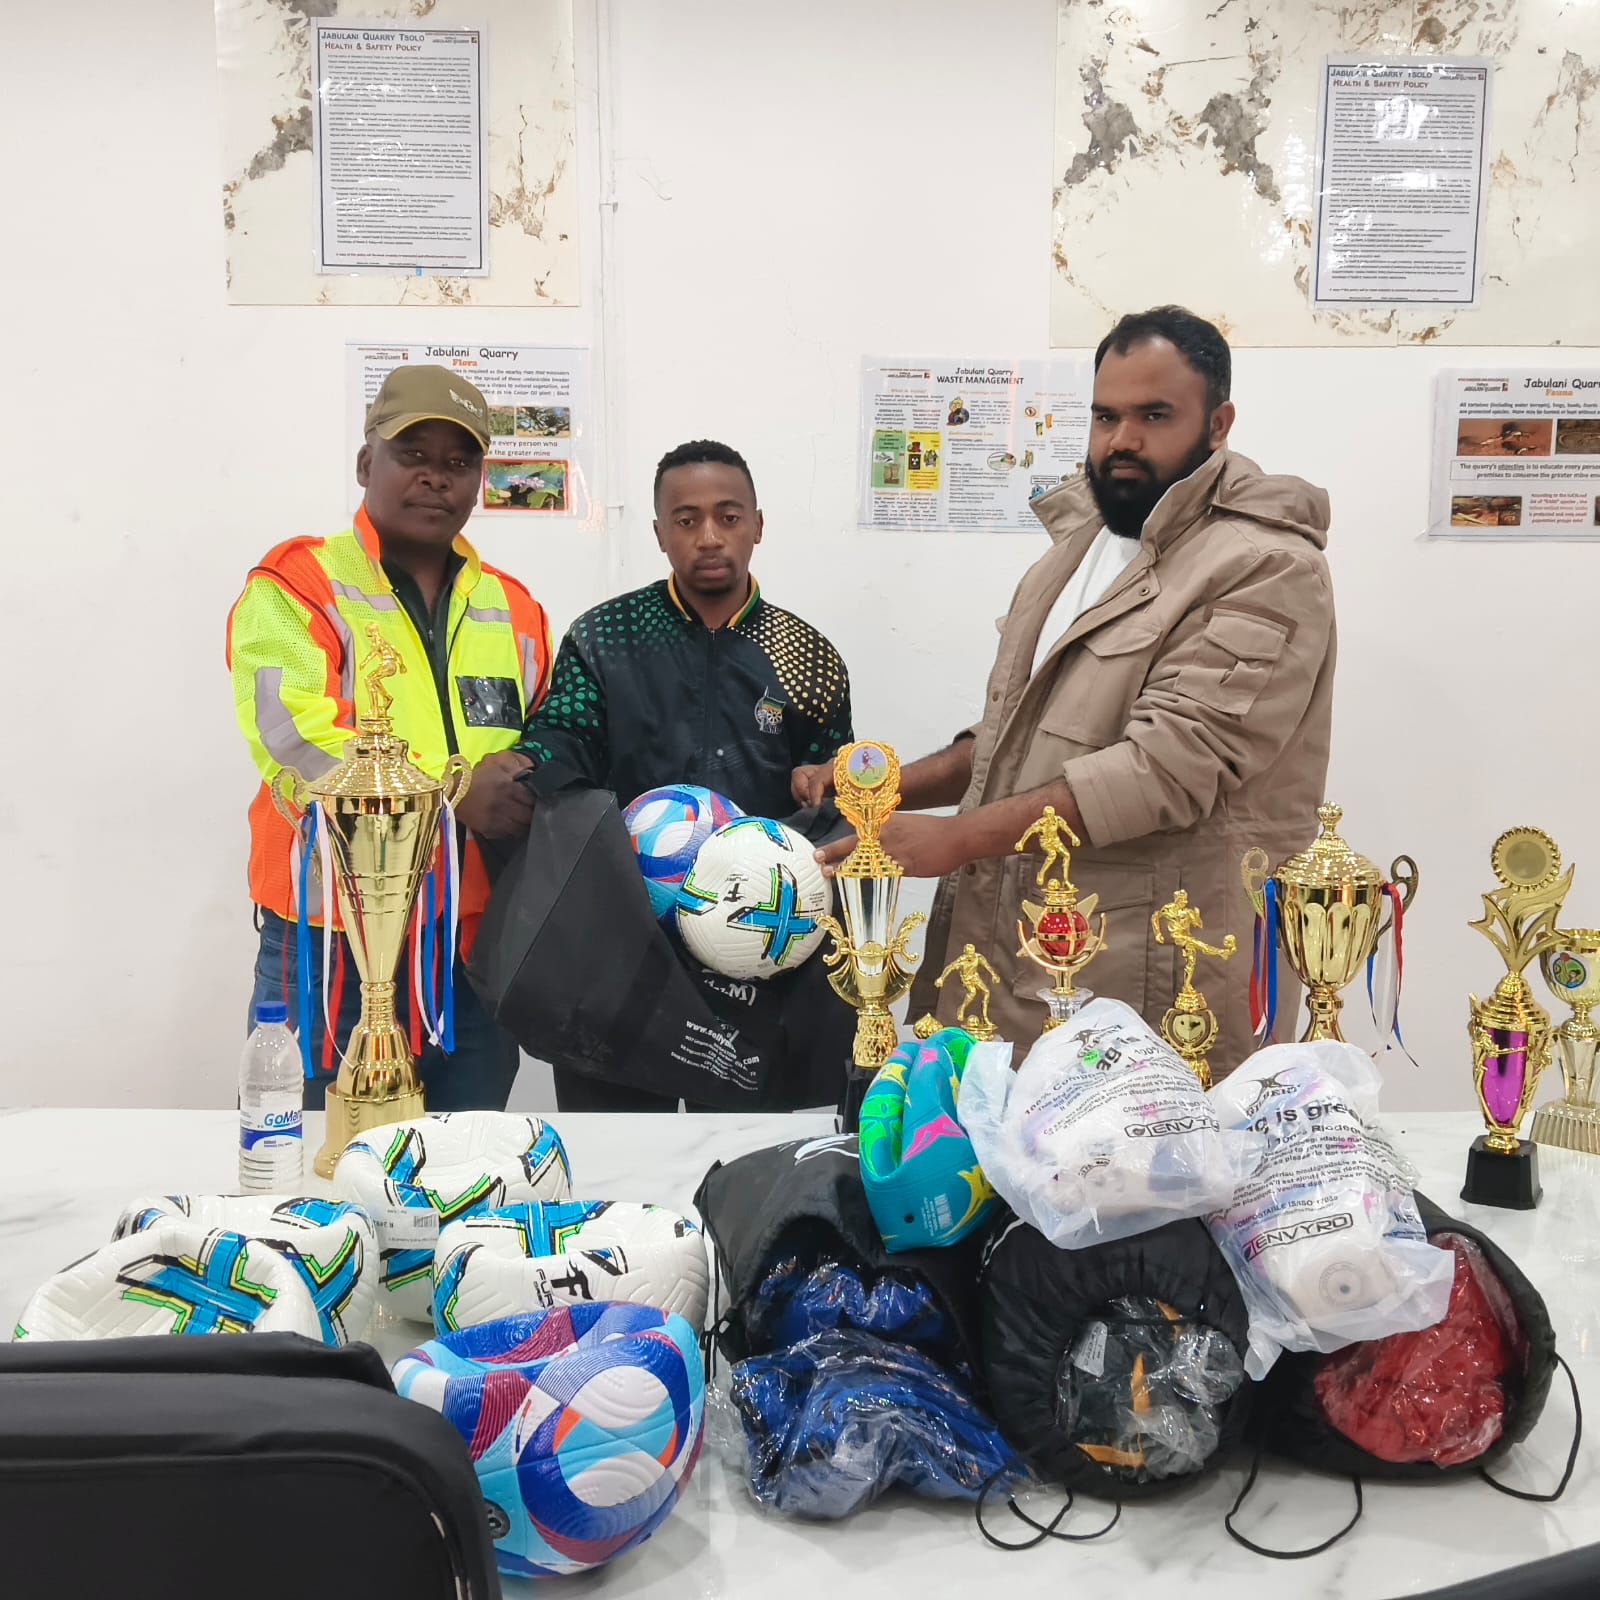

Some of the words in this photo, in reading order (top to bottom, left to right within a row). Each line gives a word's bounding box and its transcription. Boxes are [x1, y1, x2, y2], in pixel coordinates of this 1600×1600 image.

[365, 43, 392, 51] SAFETY
[396, 43, 422, 52] POLICY
[1333, 79, 1362, 87] HEALTH
[1374, 80, 1400, 88] SAFETY
[1404, 80, 1429, 89] POLICY
[425, 346, 470, 357] Jabulani
[479, 348, 518, 361] Quarry
[955, 367, 985, 375] Jabulani
[988, 368, 1014, 376] Quarry
[936, 376, 963, 384] WASTE
[965, 376, 1025, 385] MANAGEMENT
[1524, 378, 1567, 388] Jabulani
[1276, 1108, 1298, 1123] is
[1255, 1215, 1349, 1250] ENVYRO
